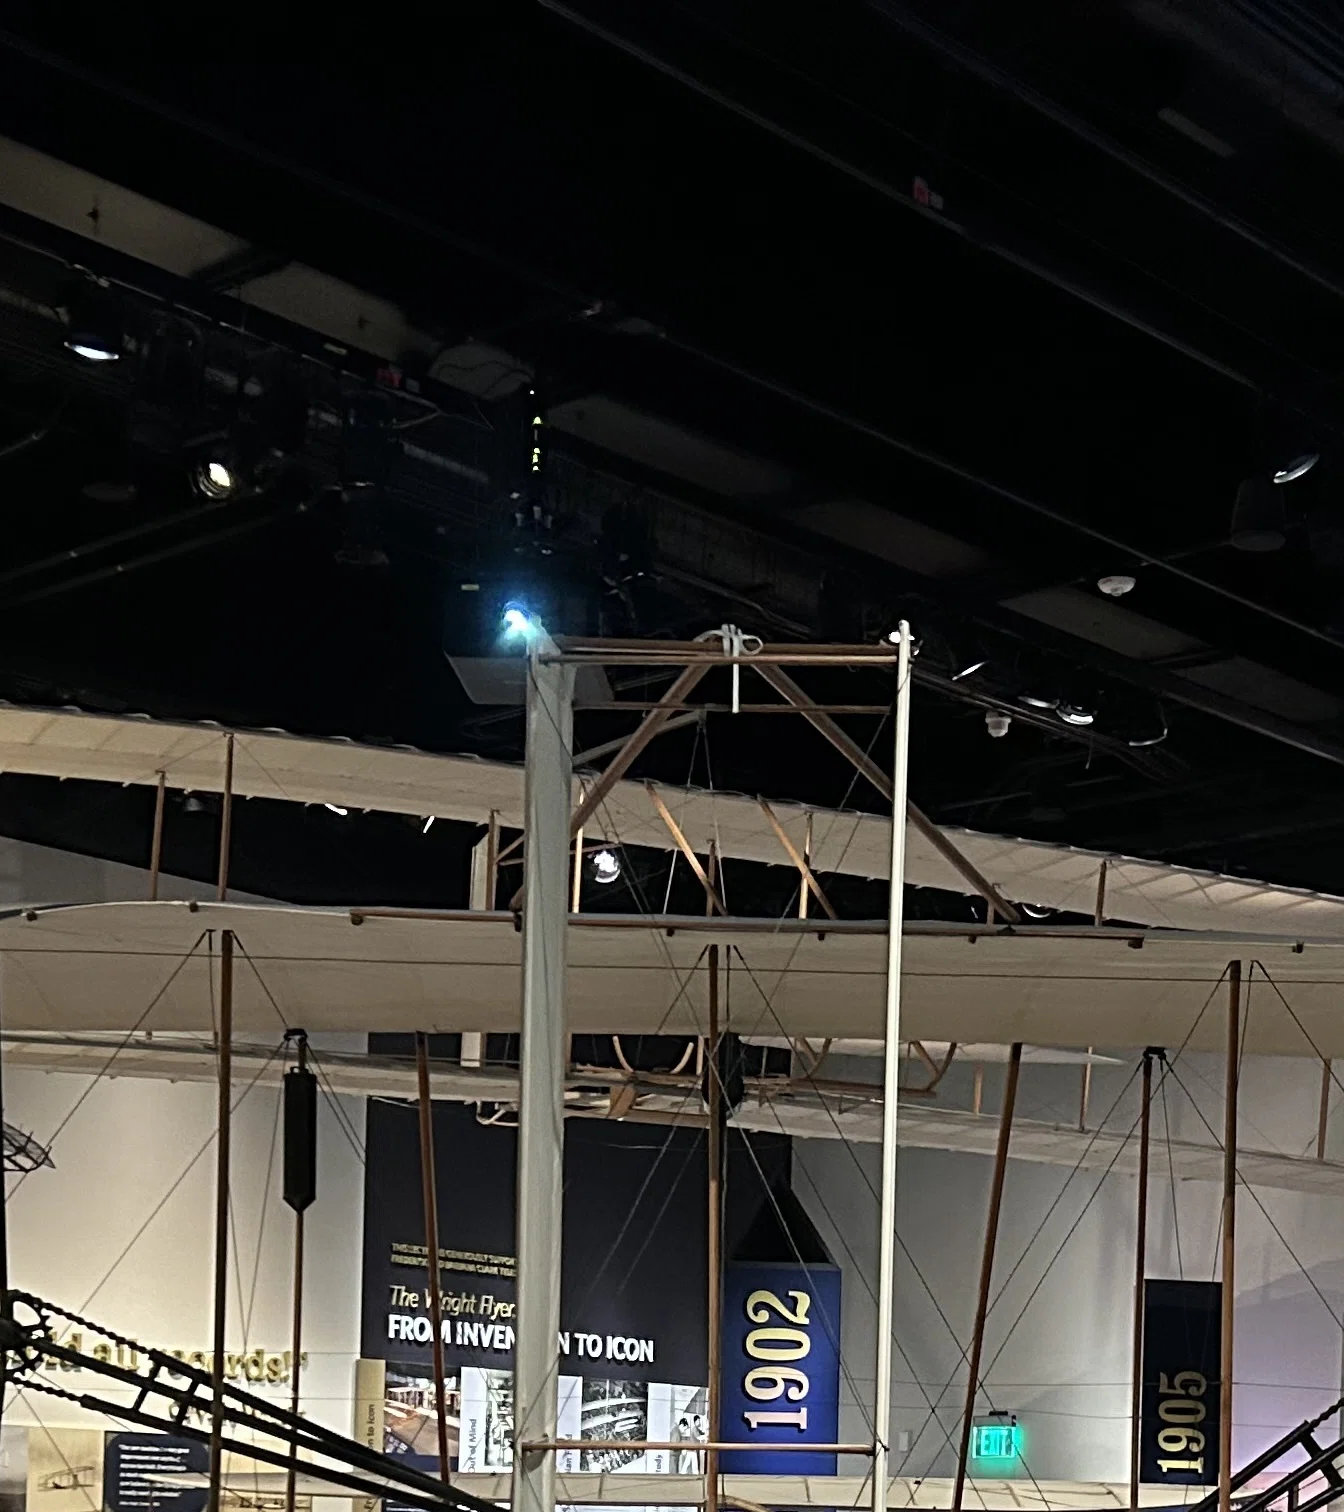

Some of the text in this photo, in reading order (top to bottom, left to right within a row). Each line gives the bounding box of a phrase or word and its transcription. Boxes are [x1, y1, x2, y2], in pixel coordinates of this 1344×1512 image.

[390, 1284, 419, 1308] The
[388, 1313, 654, 1363] FROM INVENN TO ICON
[744, 1289, 811, 1430] 1902
[468, 1418, 477, 1443] Mind
[1157, 1370, 1207, 1475] 1905
